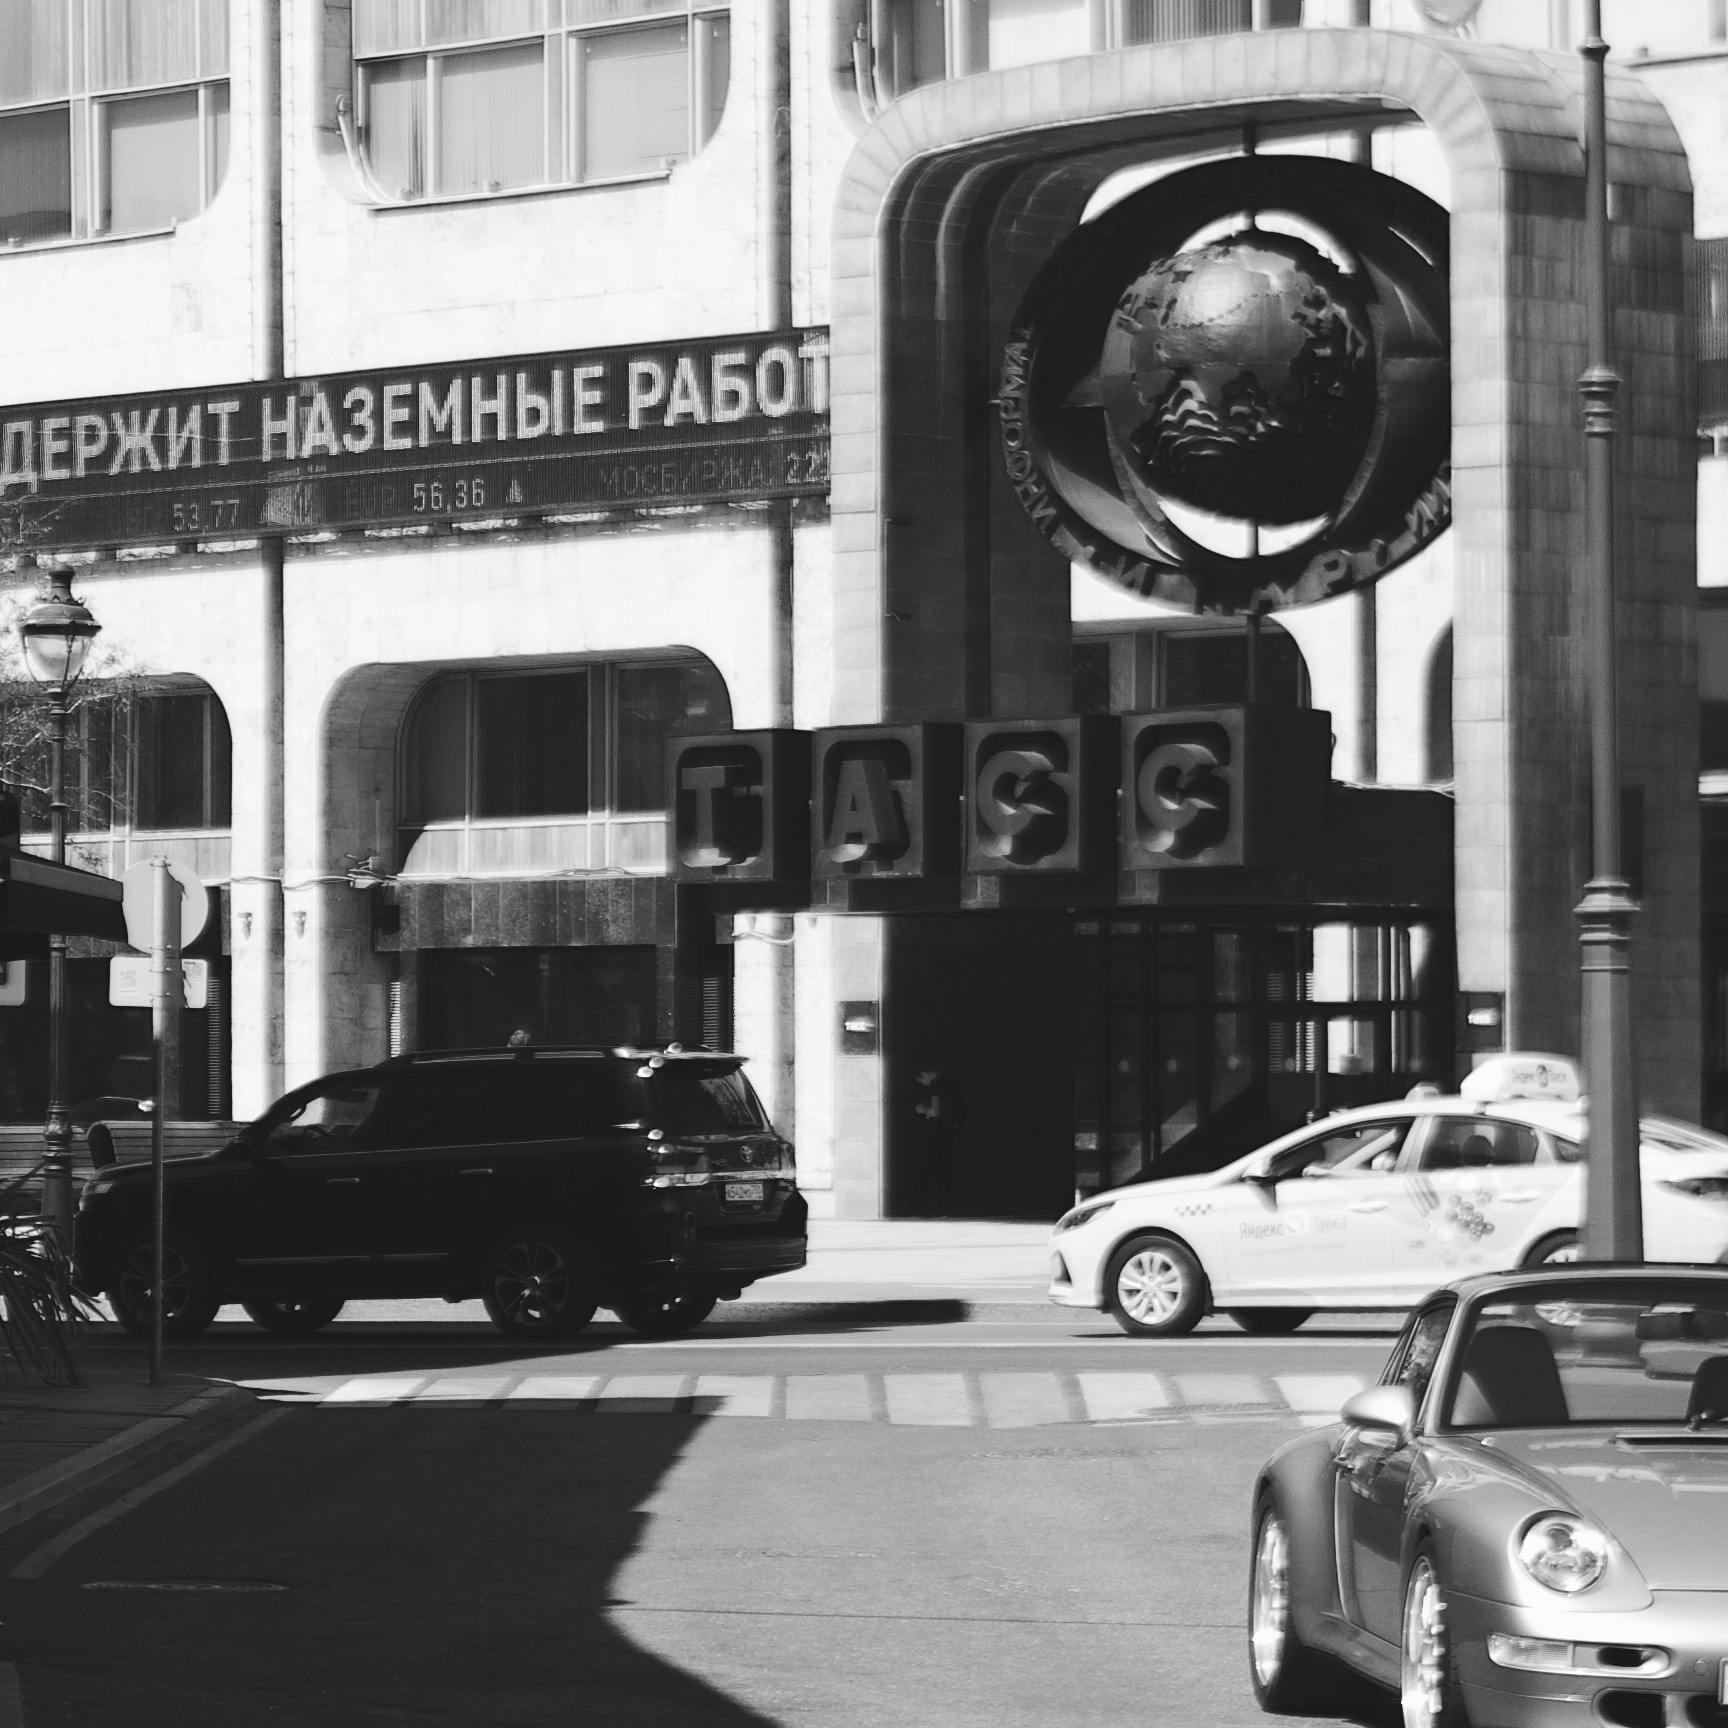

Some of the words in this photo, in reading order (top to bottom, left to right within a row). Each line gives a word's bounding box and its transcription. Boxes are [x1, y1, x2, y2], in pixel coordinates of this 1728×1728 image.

[262, 364, 605, 463] НАЗЕМНЫЕ
[412, 477, 486, 513] 56,36
[680, 743, 1220, 852] ТАСС
